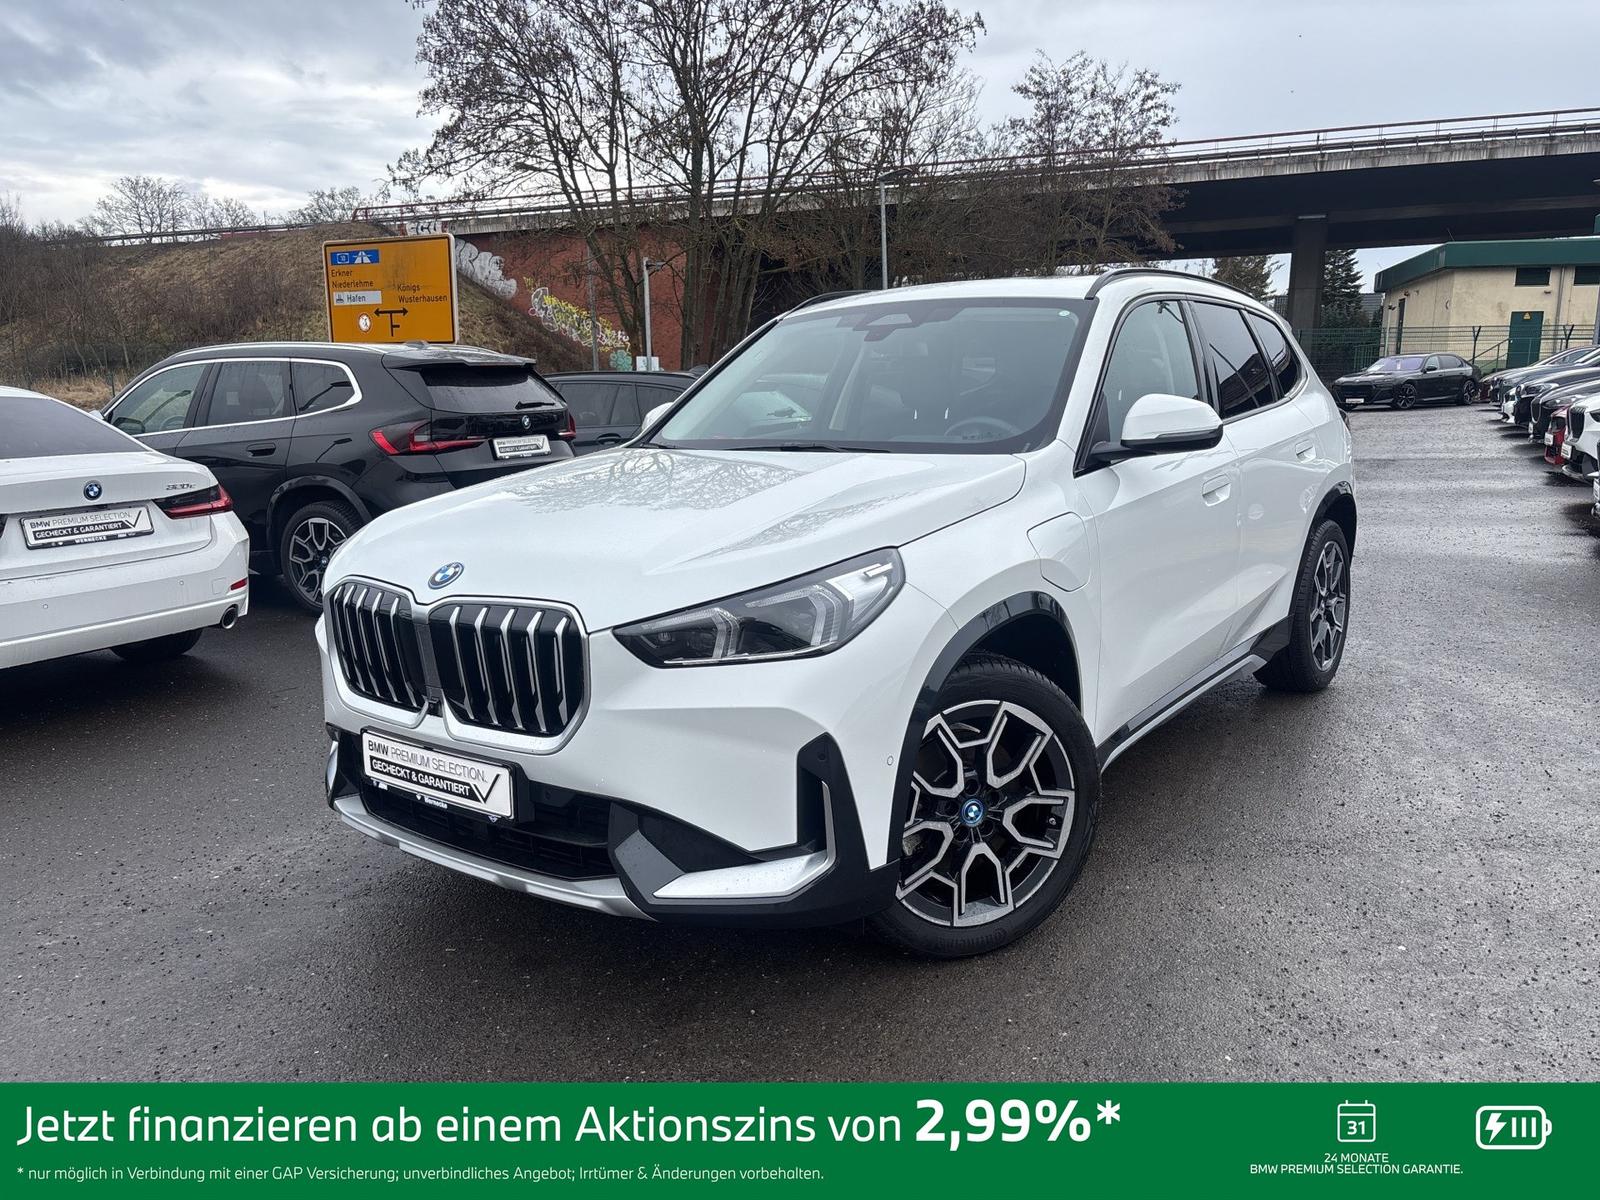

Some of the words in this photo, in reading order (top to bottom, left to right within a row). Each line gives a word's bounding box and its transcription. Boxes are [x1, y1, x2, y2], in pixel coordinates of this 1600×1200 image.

[331, 269, 353, 277] Erkner
[332, 280, 374, 289] Niederlehme
[397, 283, 420, 292] Königs
[347, 294, 366, 303] Hafen
[399, 295, 447, 304] Wusterhausen
[30, 520, 51, 529] BMW
[52, 515, 88, 526] PREMIUM
[35, 528, 72, 539] GECHECKT
[81, 522, 122, 533] GARANTIERT
[368, 739, 389, 756] BMW
[391, 746, 431, 768] PREMIUM
[372, 759, 411, 780] GECHECKT
[411, 771, 418, 783] &
[418, 774, 470, 797] GARANTIERT
